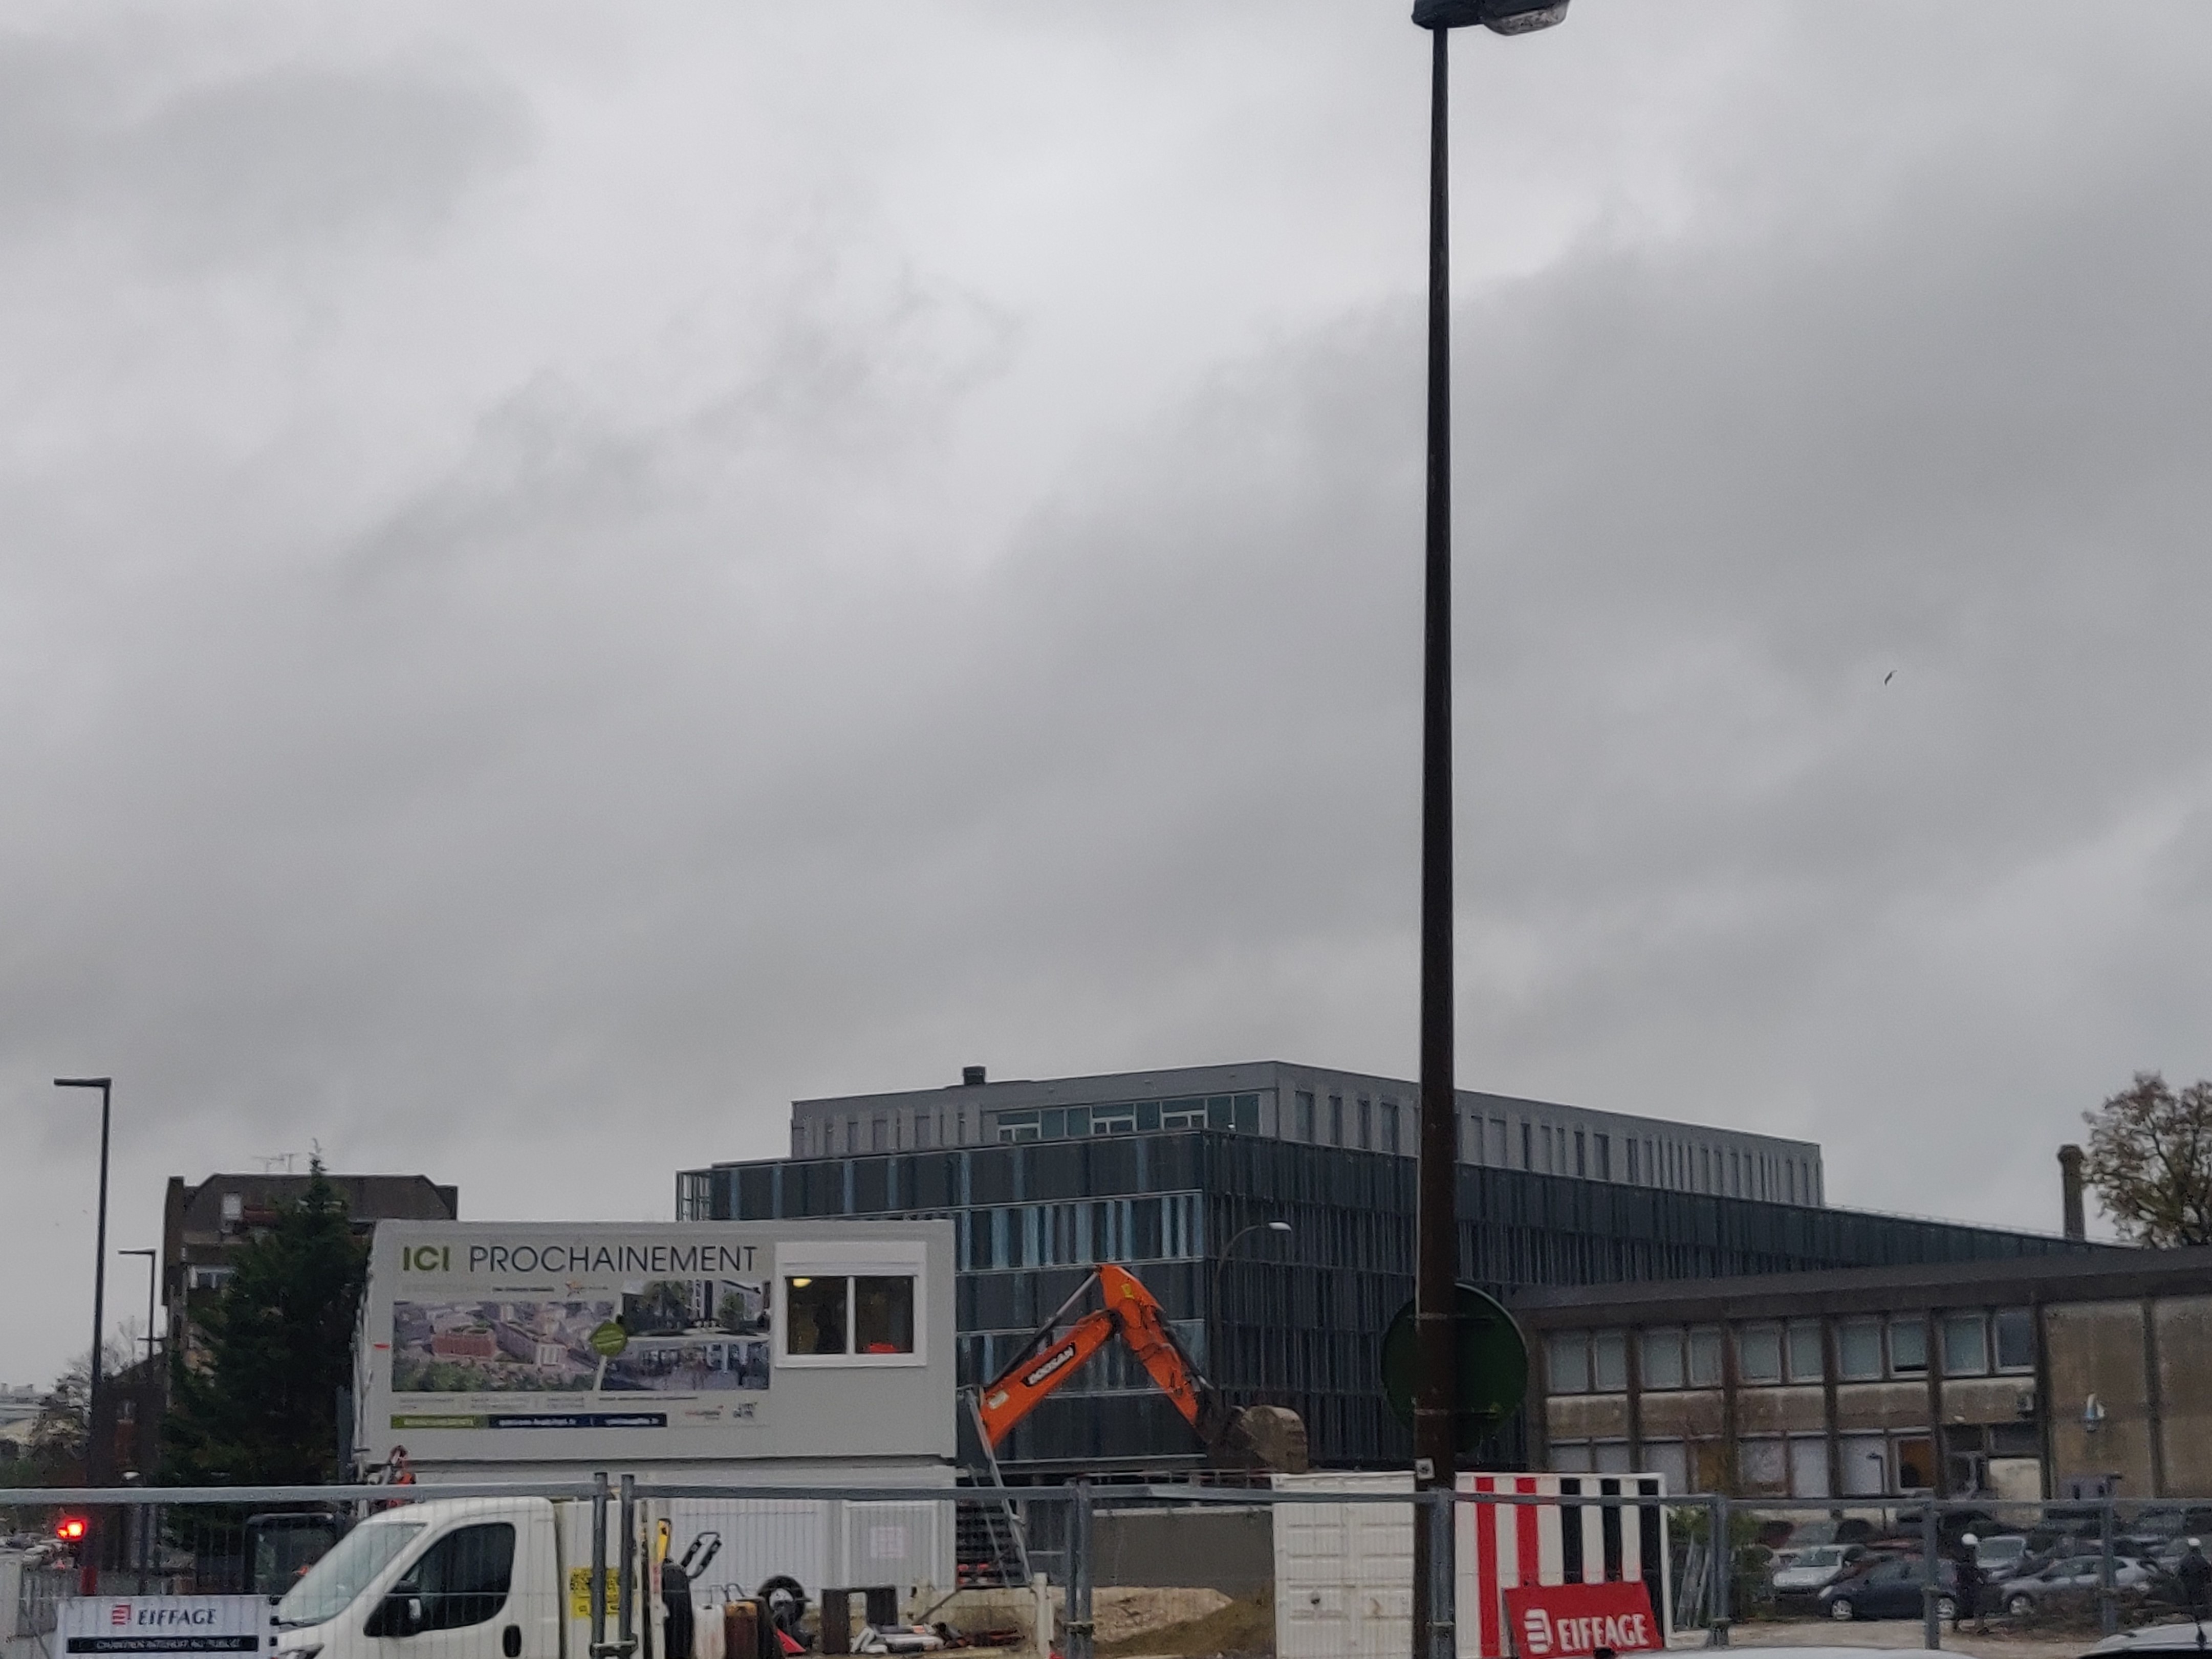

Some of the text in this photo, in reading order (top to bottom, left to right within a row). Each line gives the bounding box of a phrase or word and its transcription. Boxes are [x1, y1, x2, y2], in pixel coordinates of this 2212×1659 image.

[403, 1246, 757, 1272] ICI PROCHAINEMENT
[138, 1609, 216, 1625] EIFFAGE
[1557, 1614, 1649, 1651] EIFFAGE
